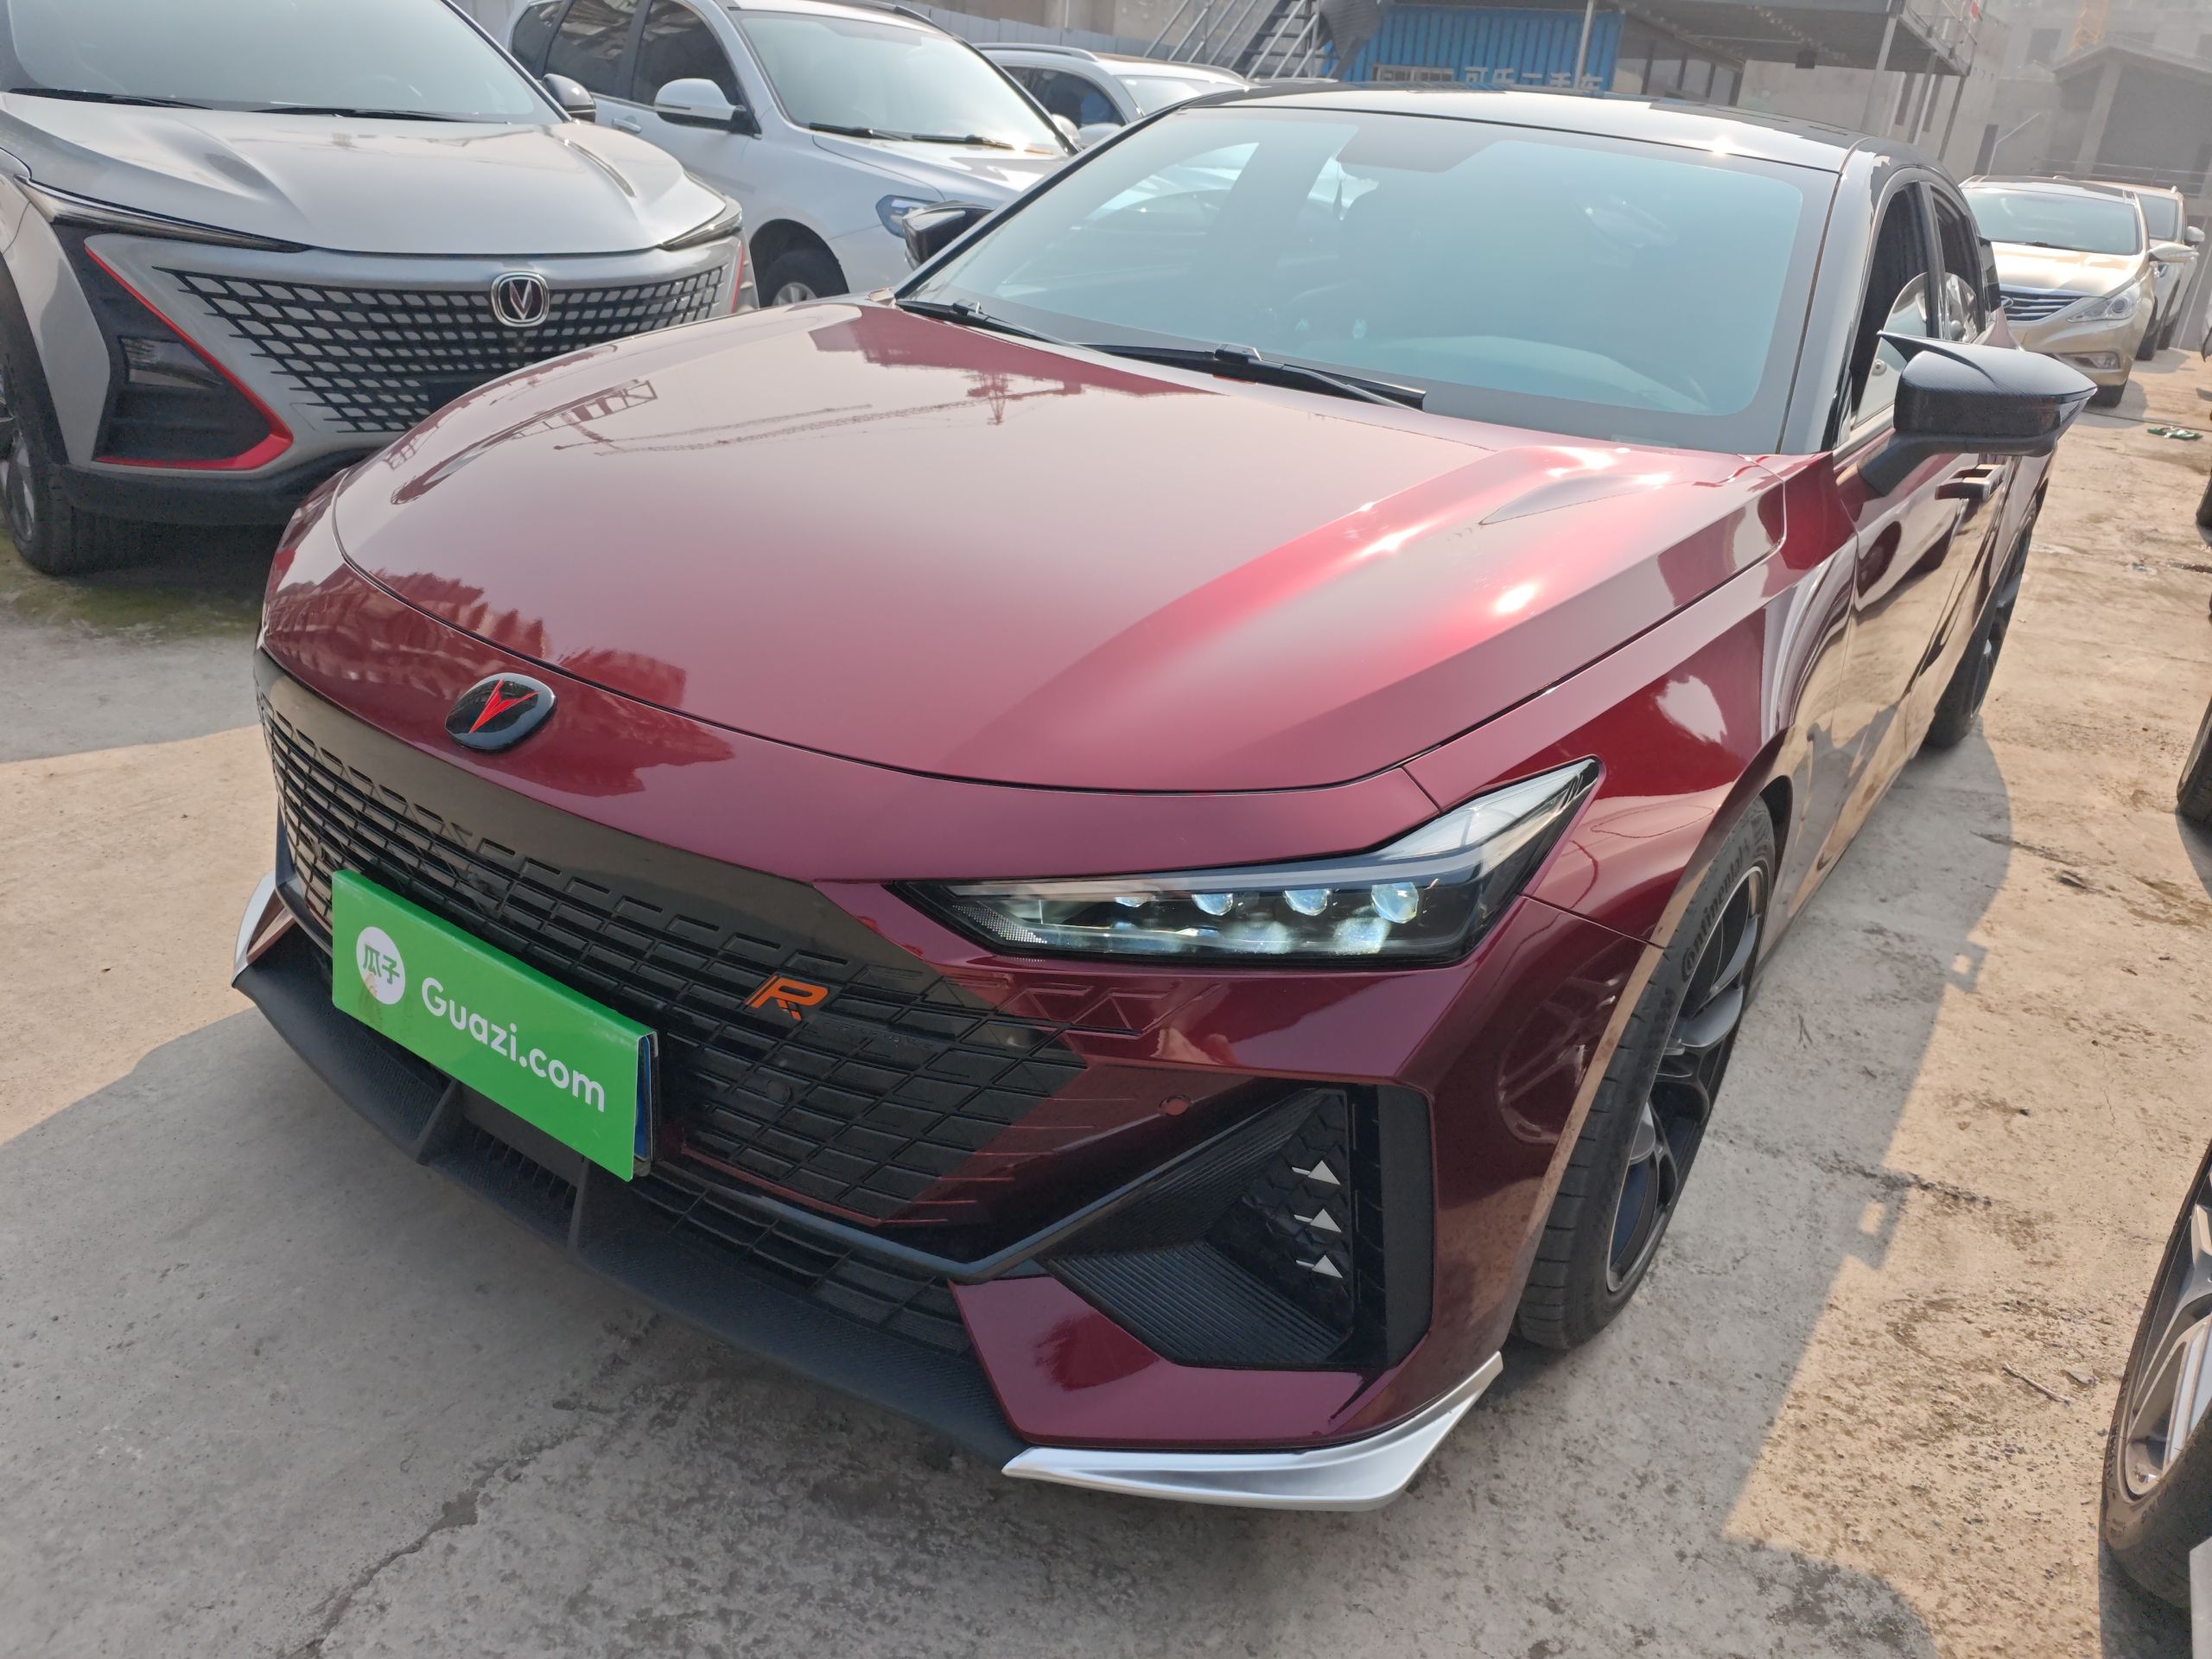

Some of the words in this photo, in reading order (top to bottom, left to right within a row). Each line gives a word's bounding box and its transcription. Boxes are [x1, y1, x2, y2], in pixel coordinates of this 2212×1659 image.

[364, 944, 400, 985] 瓜子
[743, 973, 829, 1021] R
[421, 976, 606, 1113] Guazi.com
